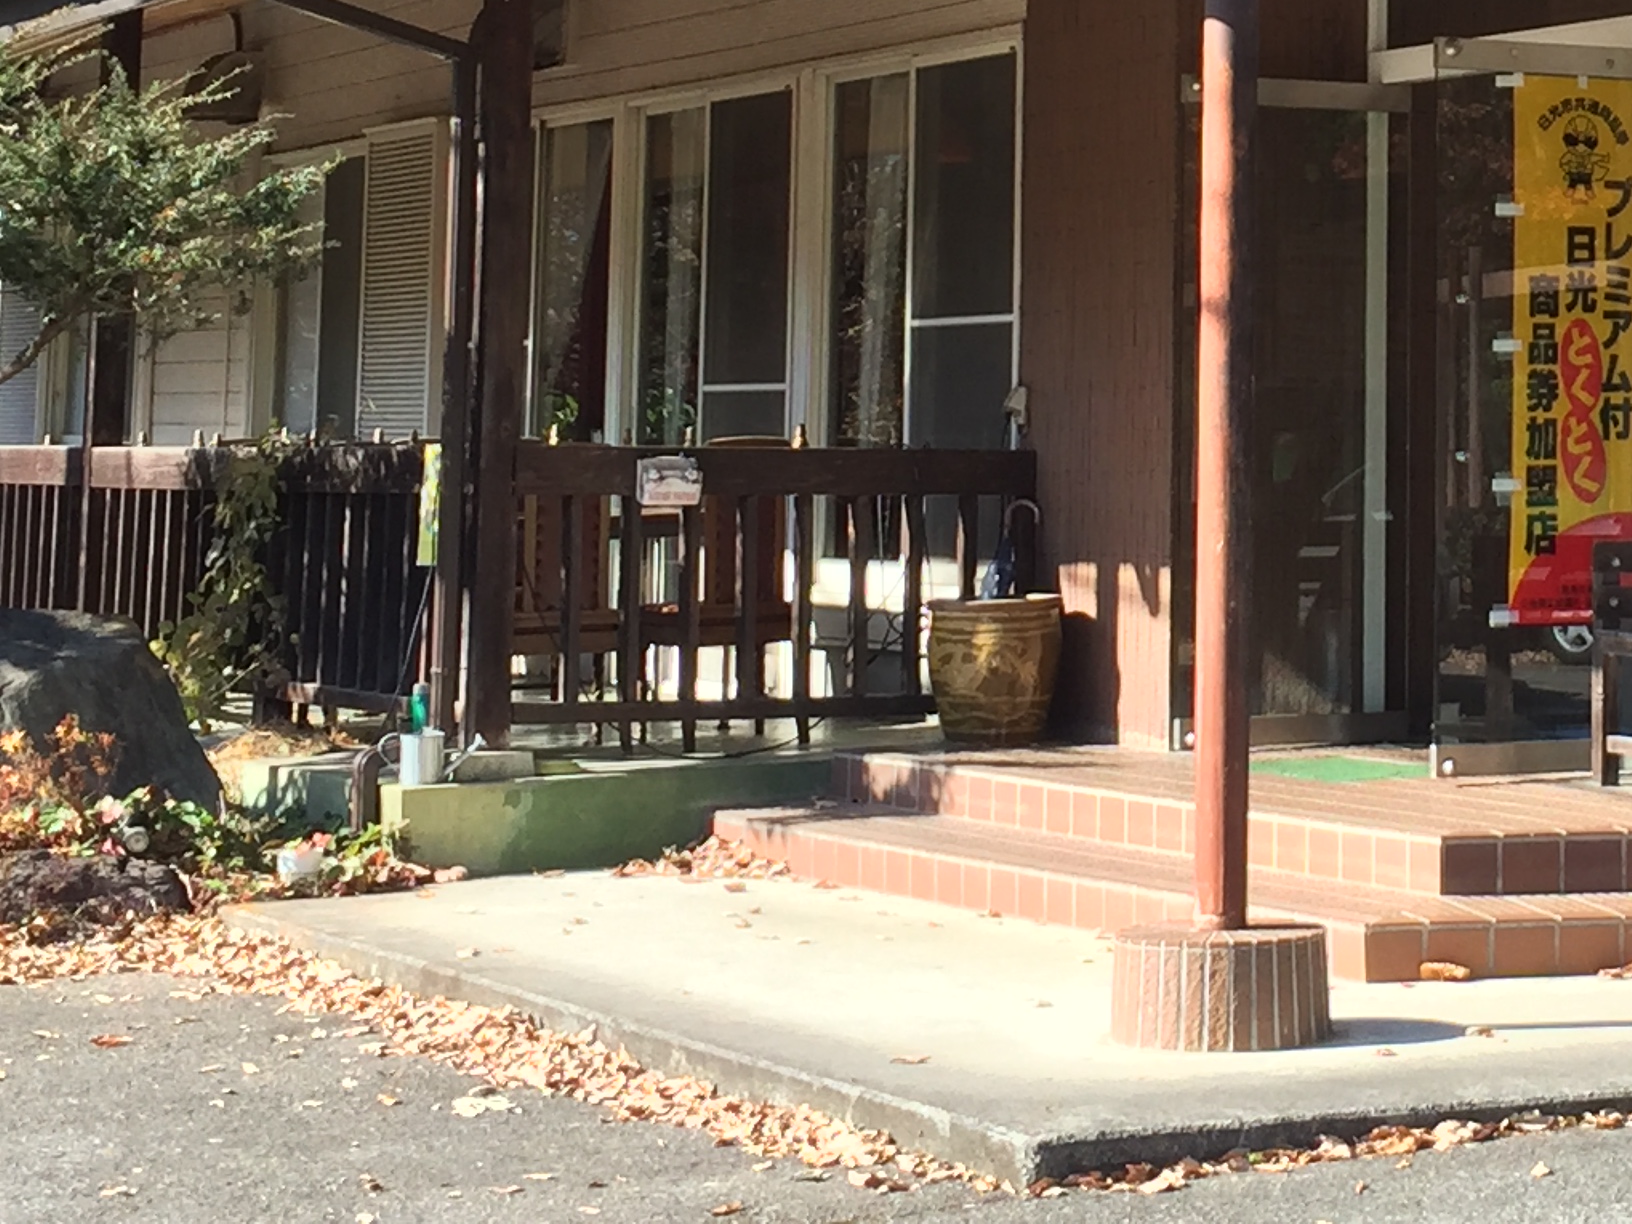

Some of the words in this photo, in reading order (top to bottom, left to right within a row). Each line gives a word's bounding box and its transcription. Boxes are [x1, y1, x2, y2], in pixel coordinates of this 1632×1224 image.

[1524, 273, 1561, 557] 商品券加盟店
